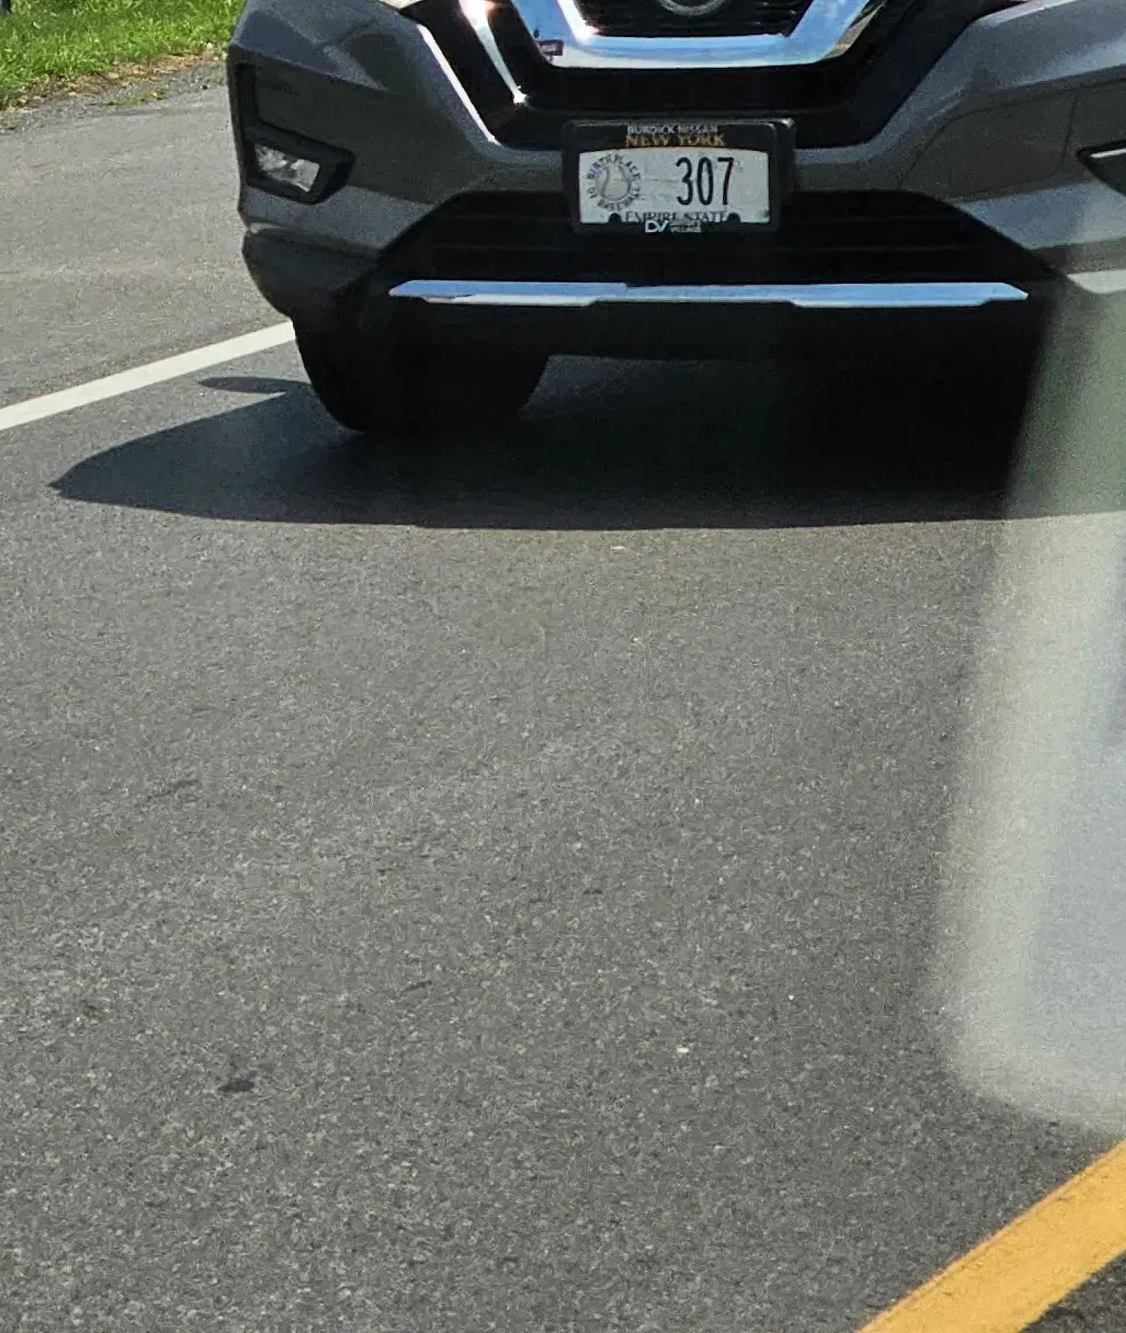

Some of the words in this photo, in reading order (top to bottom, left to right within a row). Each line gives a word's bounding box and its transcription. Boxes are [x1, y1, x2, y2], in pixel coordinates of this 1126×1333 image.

[626, 134, 670, 147] NEW
[678, 134, 725, 147] YORK
[676, 156, 735, 206] 307
